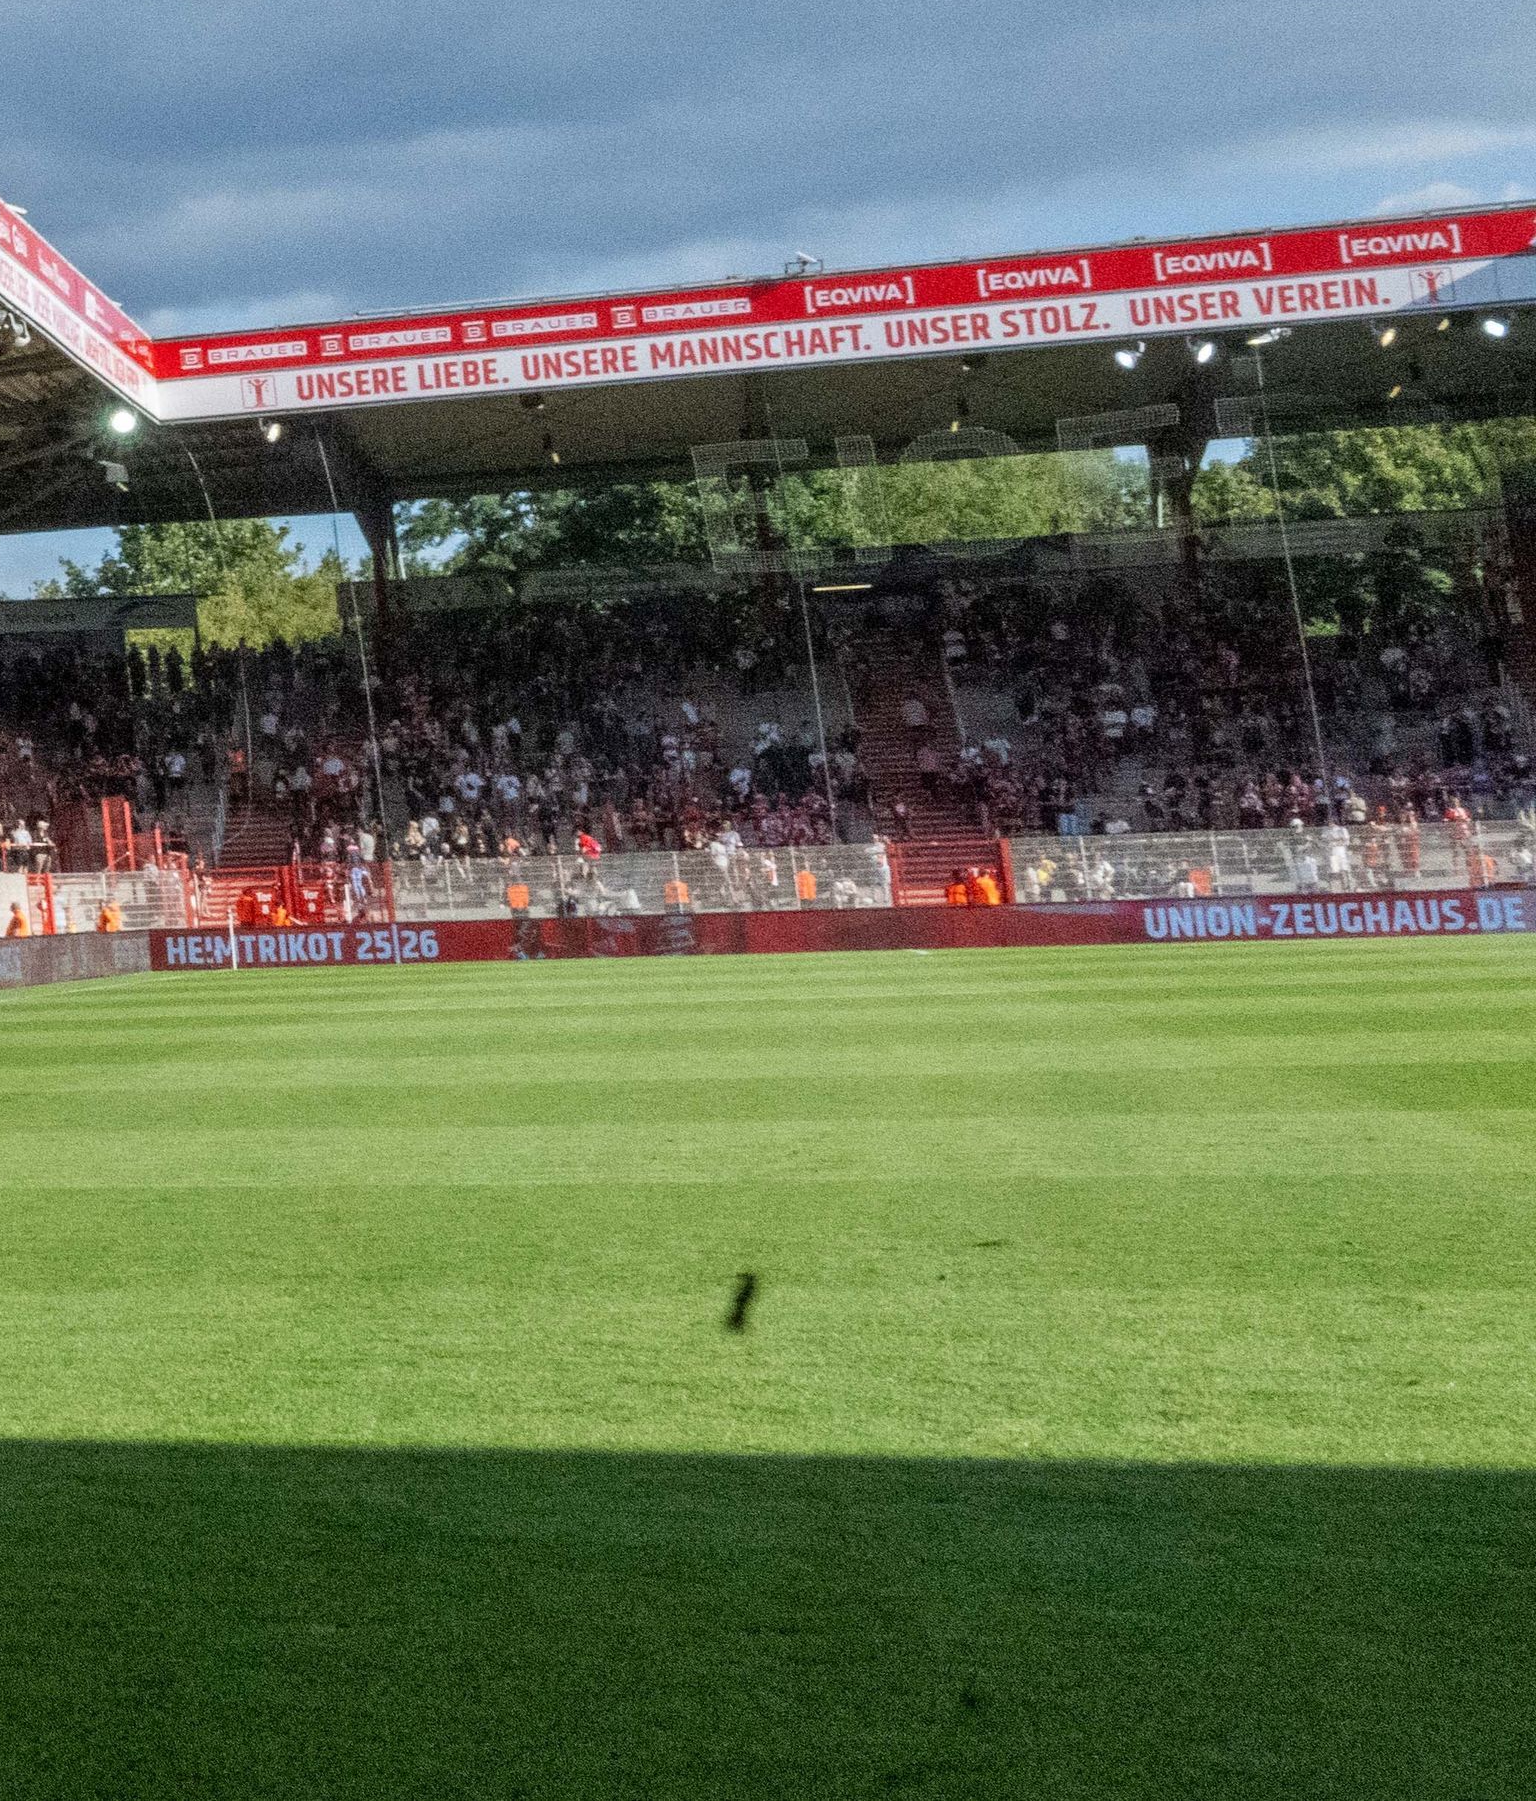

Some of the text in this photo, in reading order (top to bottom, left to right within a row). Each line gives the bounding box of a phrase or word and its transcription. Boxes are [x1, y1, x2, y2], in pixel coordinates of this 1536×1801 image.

[642, 298, 752, 324] BRAUER
[349, 325, 451, 350] BRAUER
[491, 312, 598, 338] BRAUER
[296, 276, 1390, 402] UNSERE LIEBE. UNSERE MANNSCHAFT. UNSER STOLZ. UNSER VEREIN.
[207, 341, 308, 365] BRAUER
[1142, 898, 1526, 940] UNION-ZEUGHAUS.DE
[165, 930, 345, 966] HEIMTRIKOT
